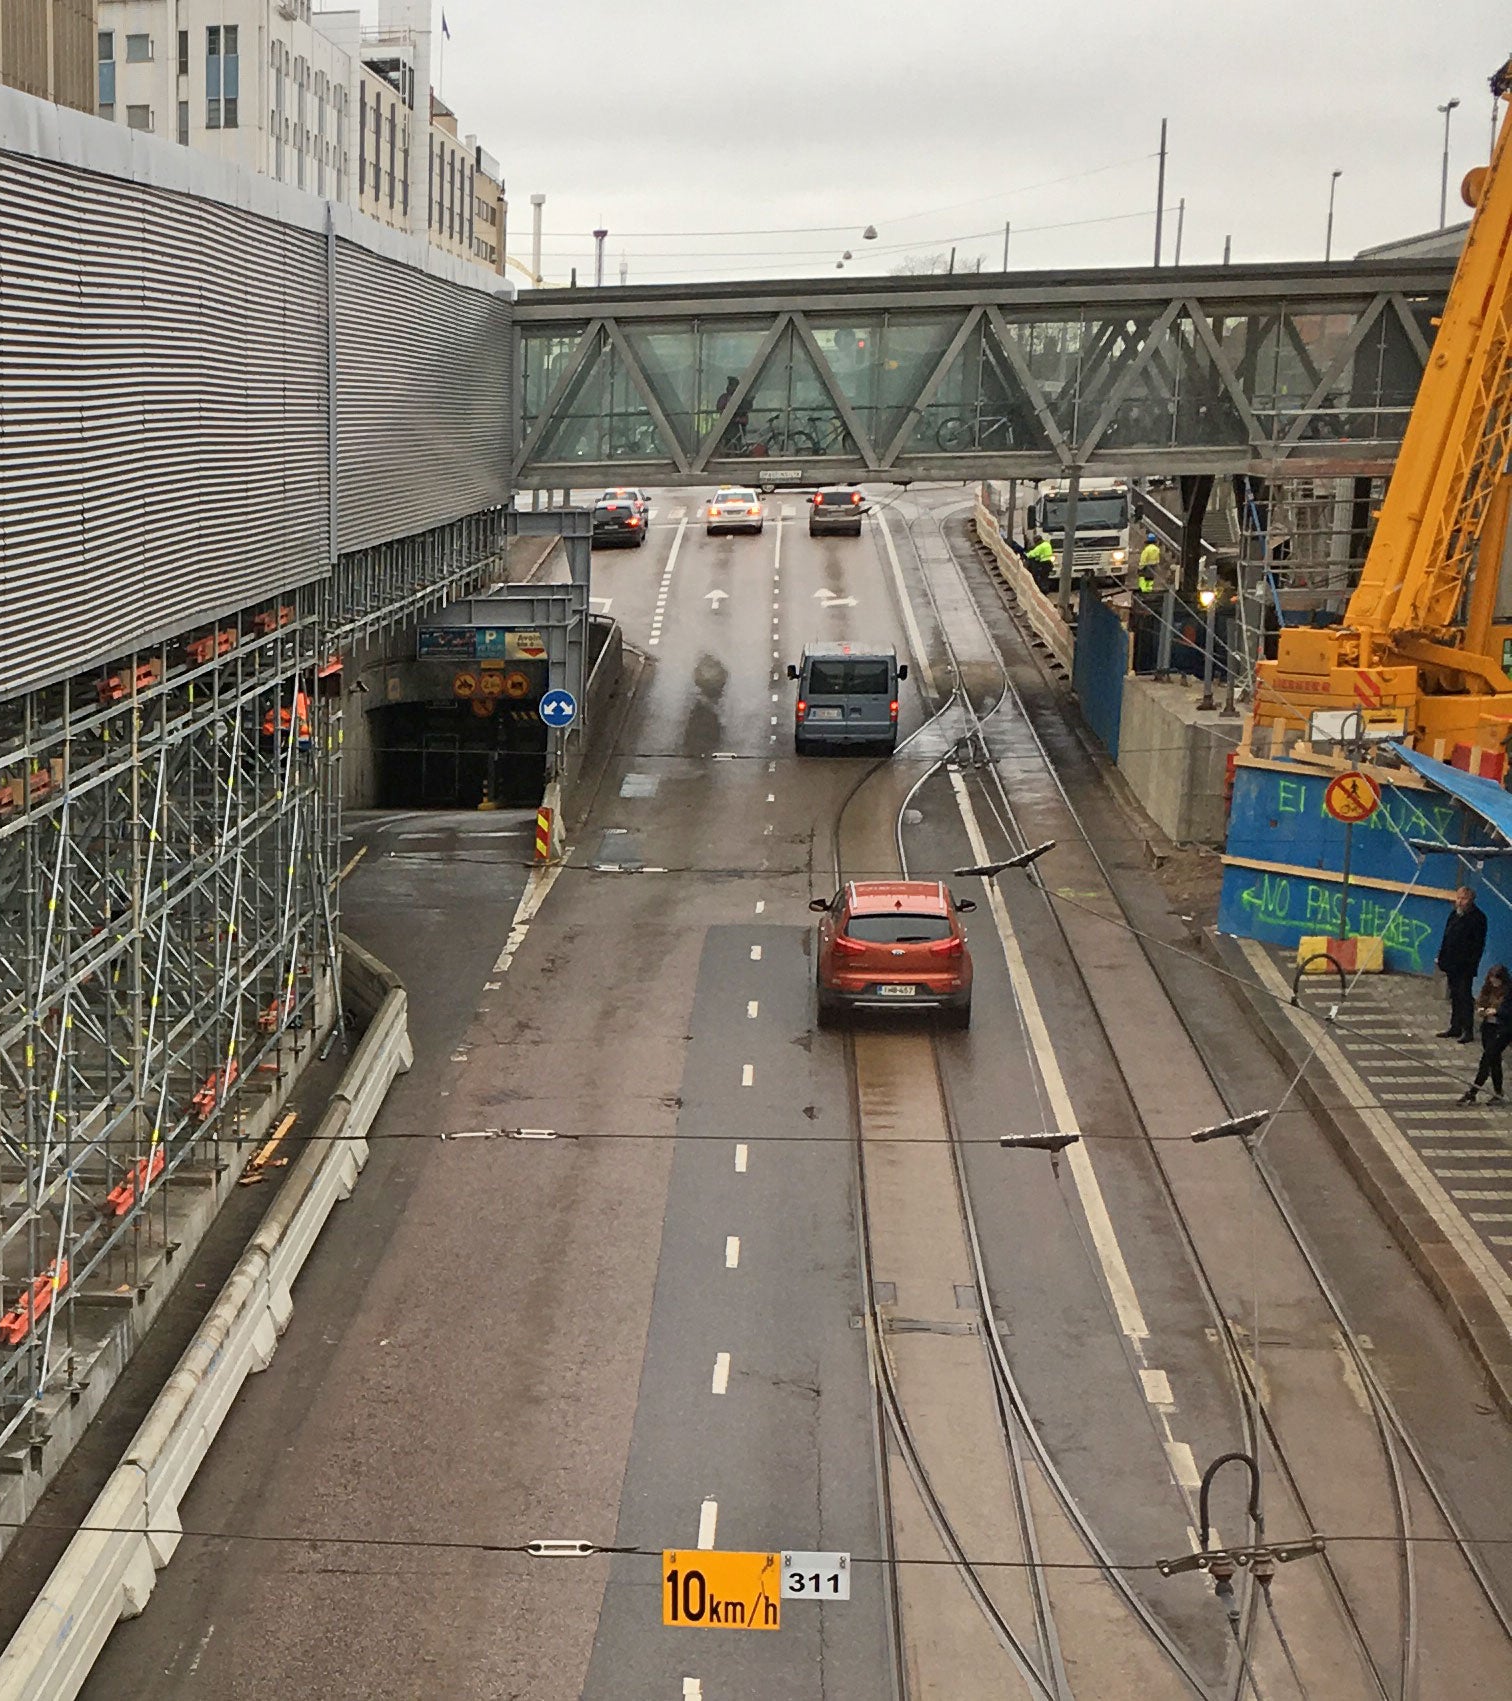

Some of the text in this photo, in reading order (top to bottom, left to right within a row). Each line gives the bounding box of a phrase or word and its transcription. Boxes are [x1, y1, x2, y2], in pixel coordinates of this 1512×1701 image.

[1278, 779, 1306, 813] EI
[1261, 874, 1290, 917] NO
[788, 1572, 840, 1594] 311
